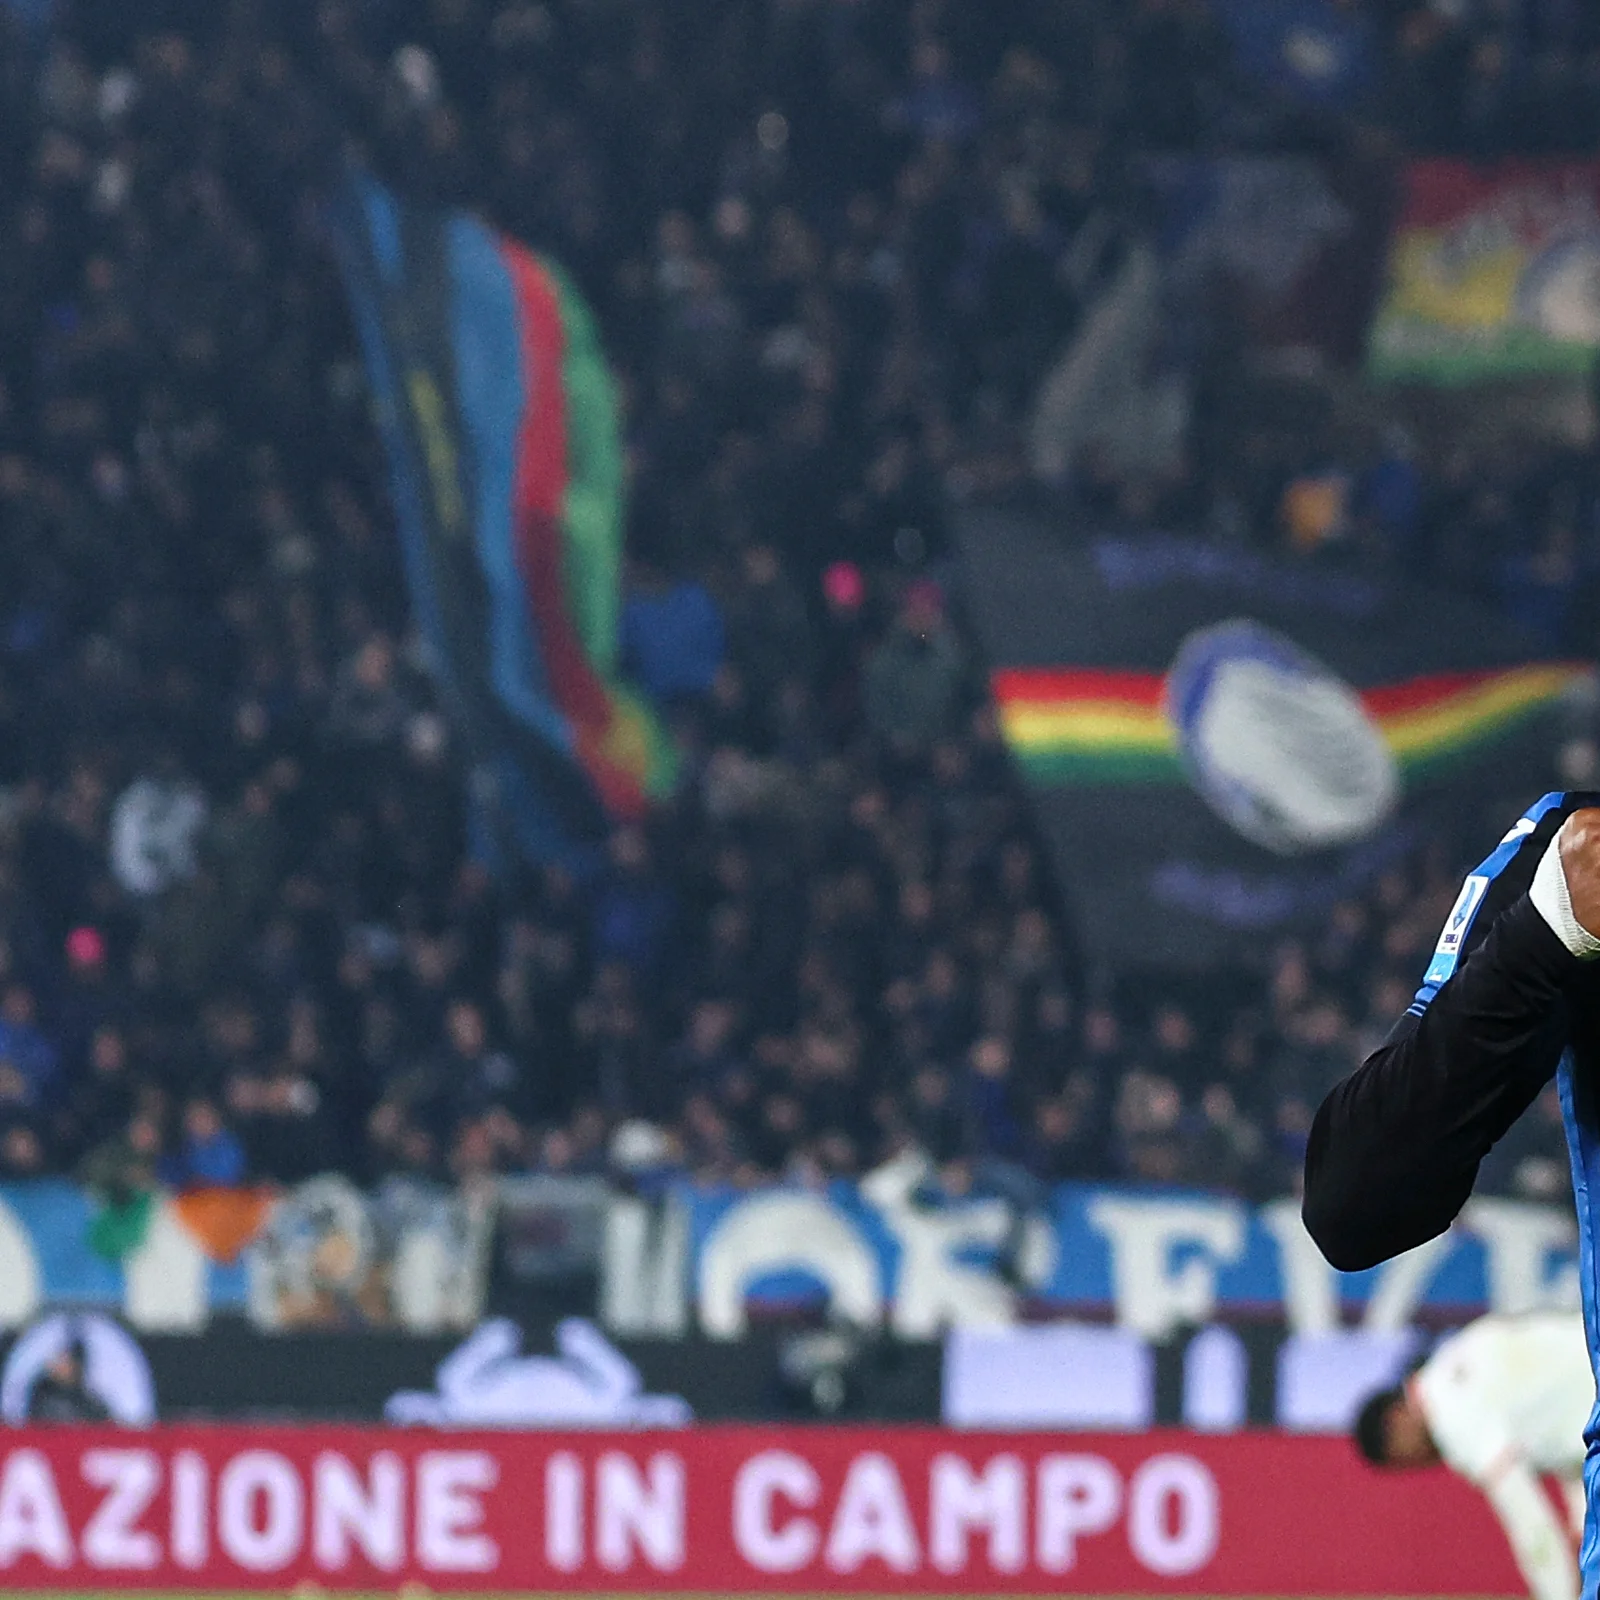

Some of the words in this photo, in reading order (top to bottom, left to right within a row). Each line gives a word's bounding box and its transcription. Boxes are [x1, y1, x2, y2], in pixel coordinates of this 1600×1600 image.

[0, 1448, 500, 1572] AZIONE
[545, 1450, 686, 1572] IN
[731, 1450, 1222, 1576] CAMPO
